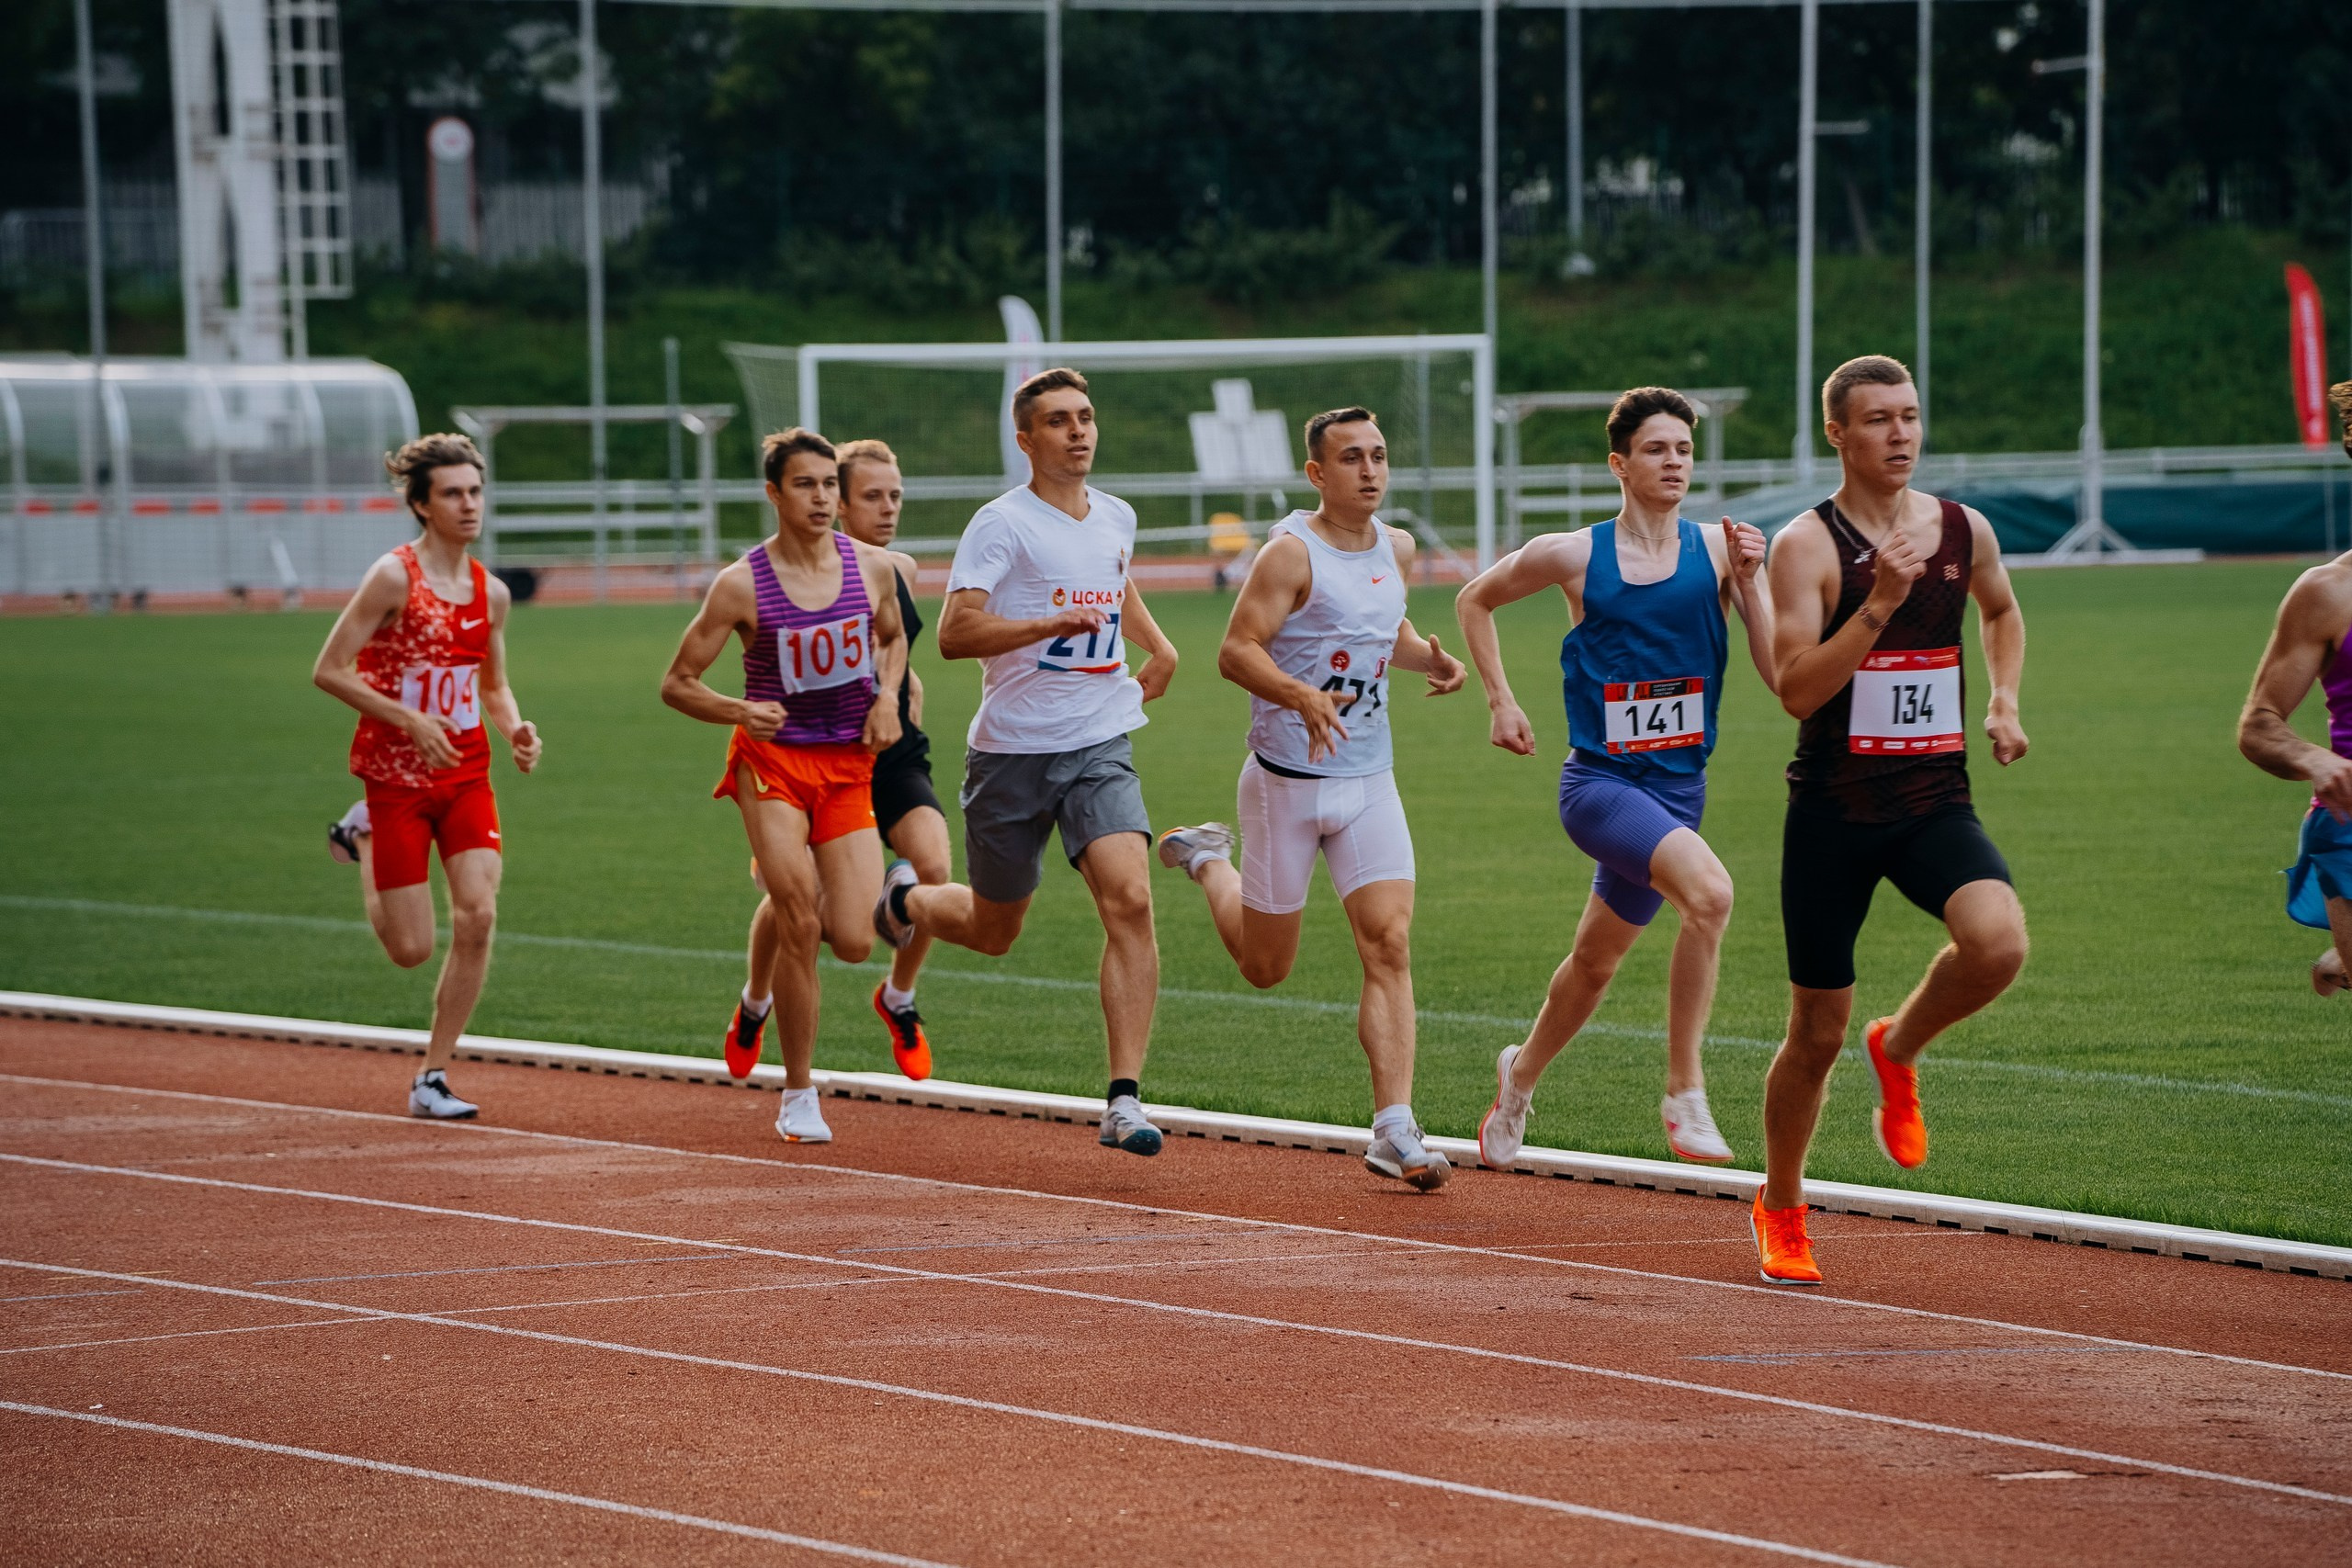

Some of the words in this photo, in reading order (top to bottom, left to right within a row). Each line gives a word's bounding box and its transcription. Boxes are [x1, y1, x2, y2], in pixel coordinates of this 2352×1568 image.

[1072, 591, 1113, 606] ЦСКА
[787, 619, 863, 679] 105
[416, 669, 474, 716] 104
[1893, 683, 1933, 725] 134
[1625, 699, 1683, 738] 141
